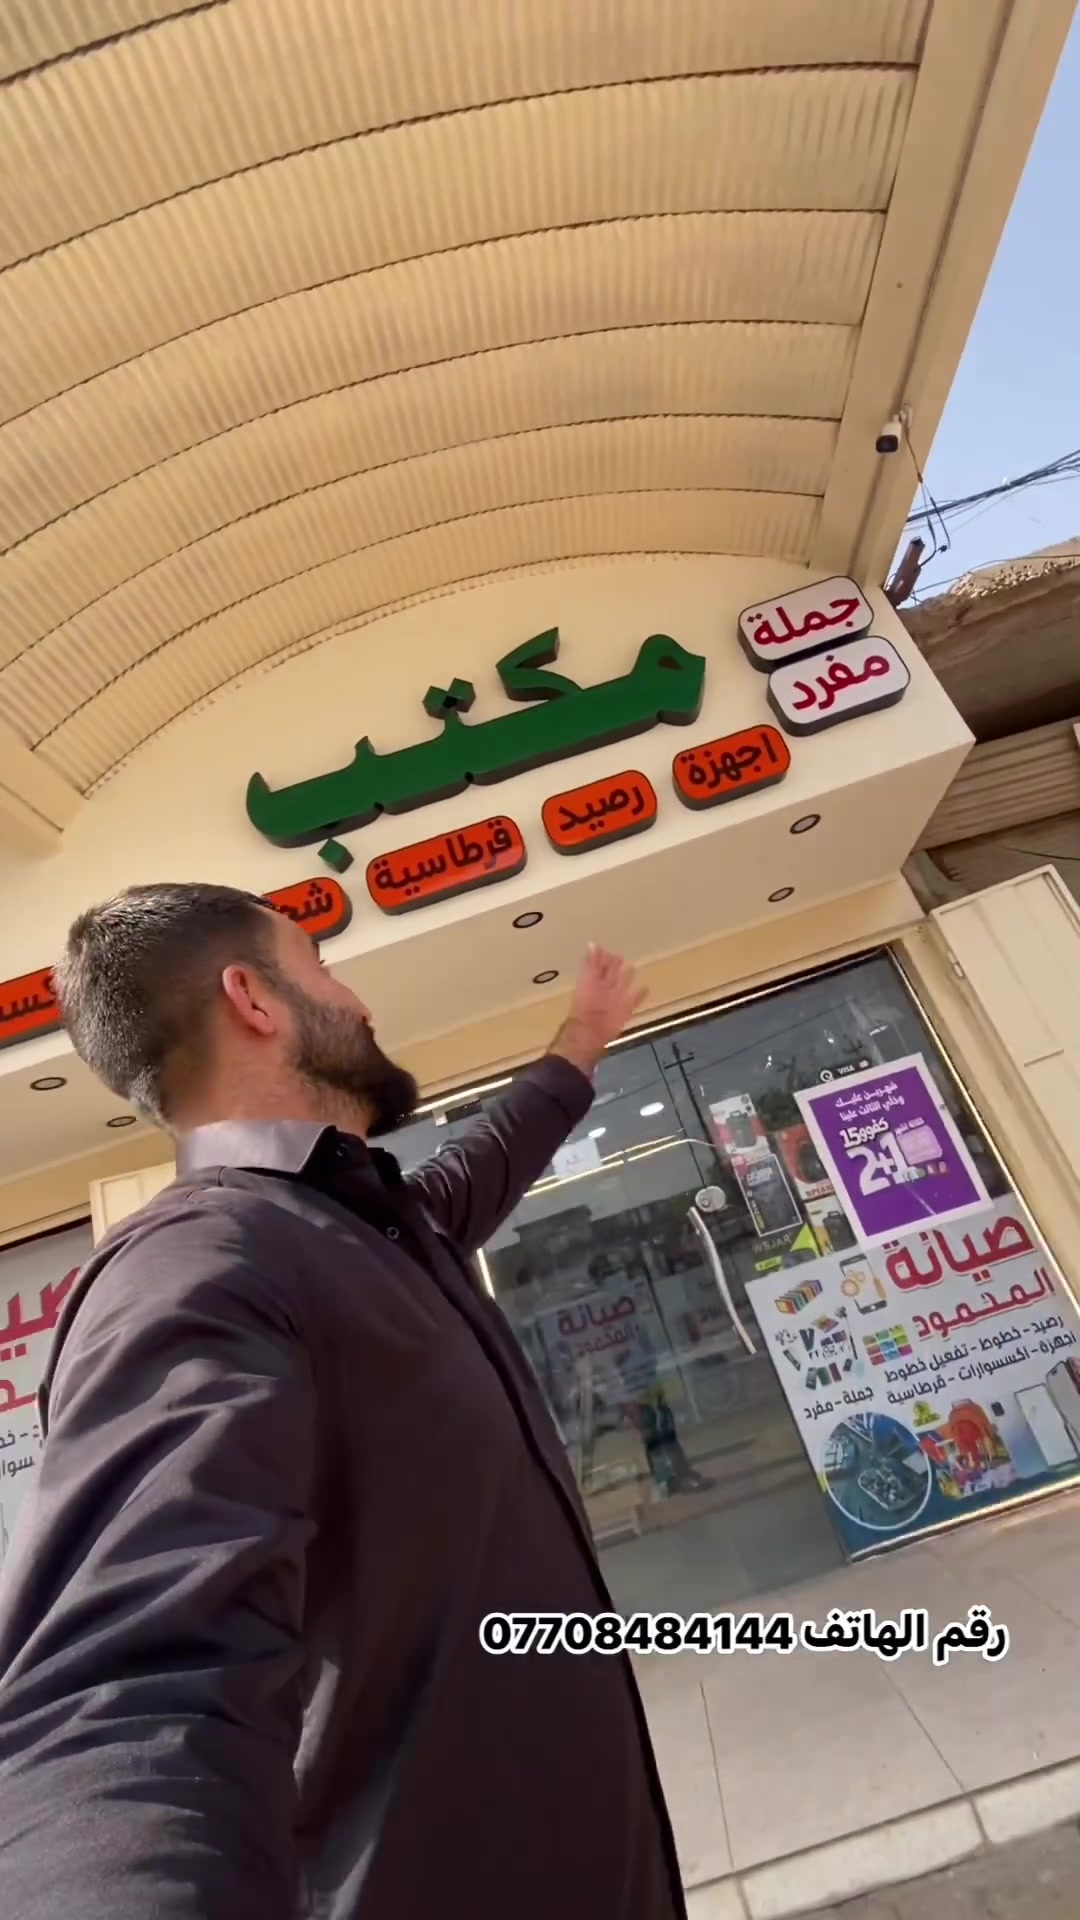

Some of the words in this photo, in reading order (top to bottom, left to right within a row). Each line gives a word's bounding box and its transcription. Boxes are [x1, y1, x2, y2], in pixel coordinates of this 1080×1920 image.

[747, 597, 860, 645] جملة
[792, 654, 890, 710] مفرد
[246, 627, 706, 874] مكتب
[680, 732, 777, 788] اجهزة
[559, 785, 645, 831] رصيد
[374, 819, 513, 896] قرطاسية
[882, 1216, 1034, 1291] صيانة
[979, 1326, 1022, 1351] خطوط
[1031, 1316, 1065, 1335] رصيد
[885, 1358, 927, 1384] خطوط
[929, 1343, 969, 1371] تفعيل
[842, 1386, 874, 1404] جملة
[887, 1375, 947, 1404] قرطاسية
[803, 1401, 834, 1420] مفرد
